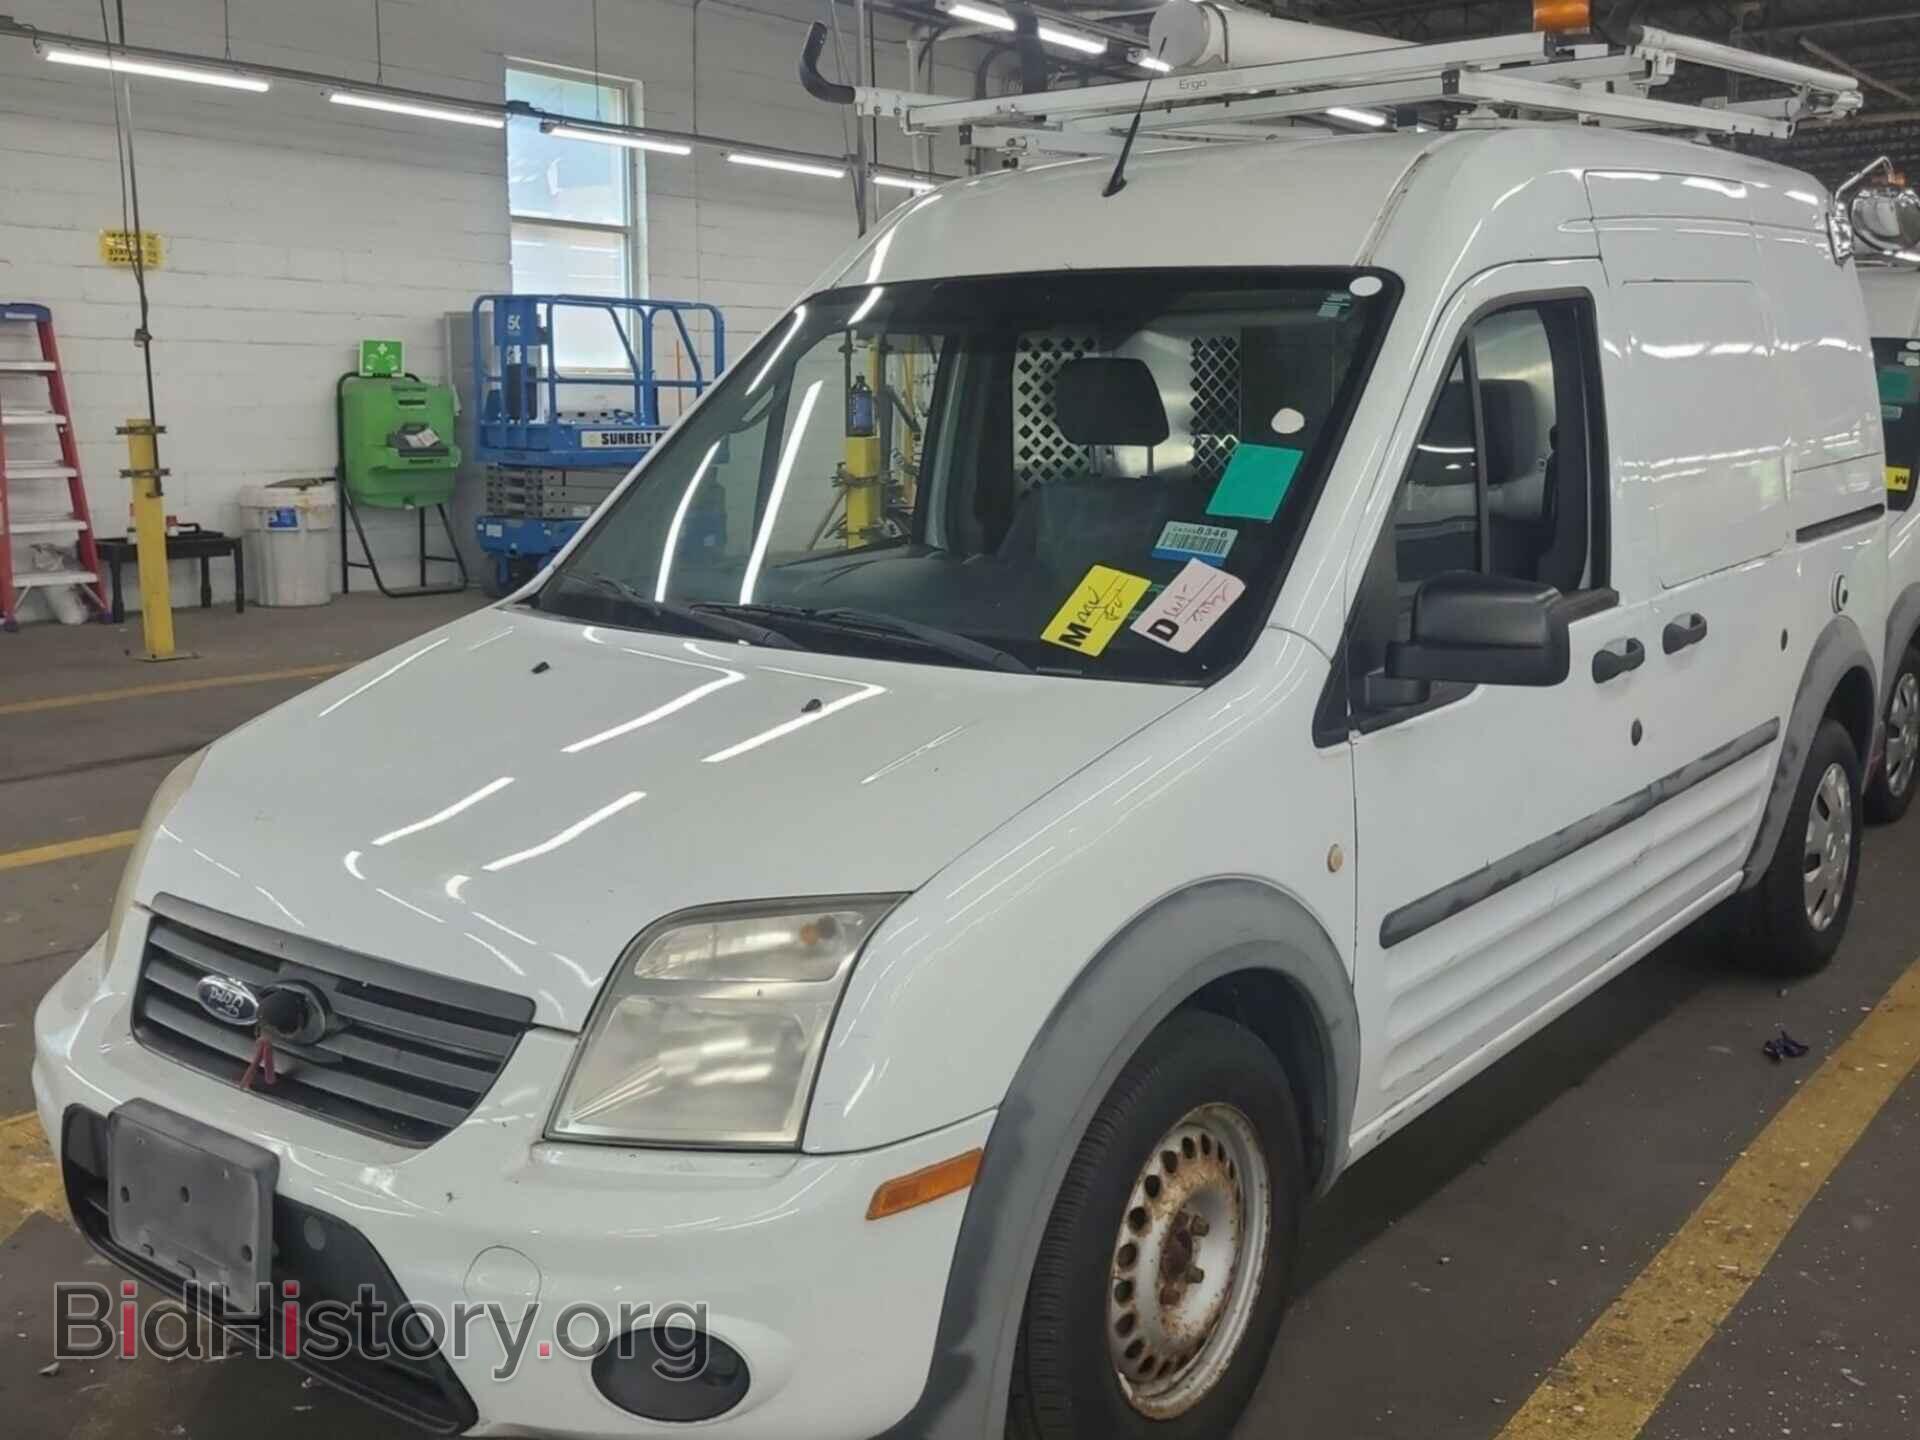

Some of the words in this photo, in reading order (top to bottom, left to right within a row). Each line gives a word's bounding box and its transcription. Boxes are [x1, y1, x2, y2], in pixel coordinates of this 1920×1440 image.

[601, 432, 652, 445] SUNBELT
[1059, 622, 1092, 647] M
[1147, 618, 1179, 641] D
